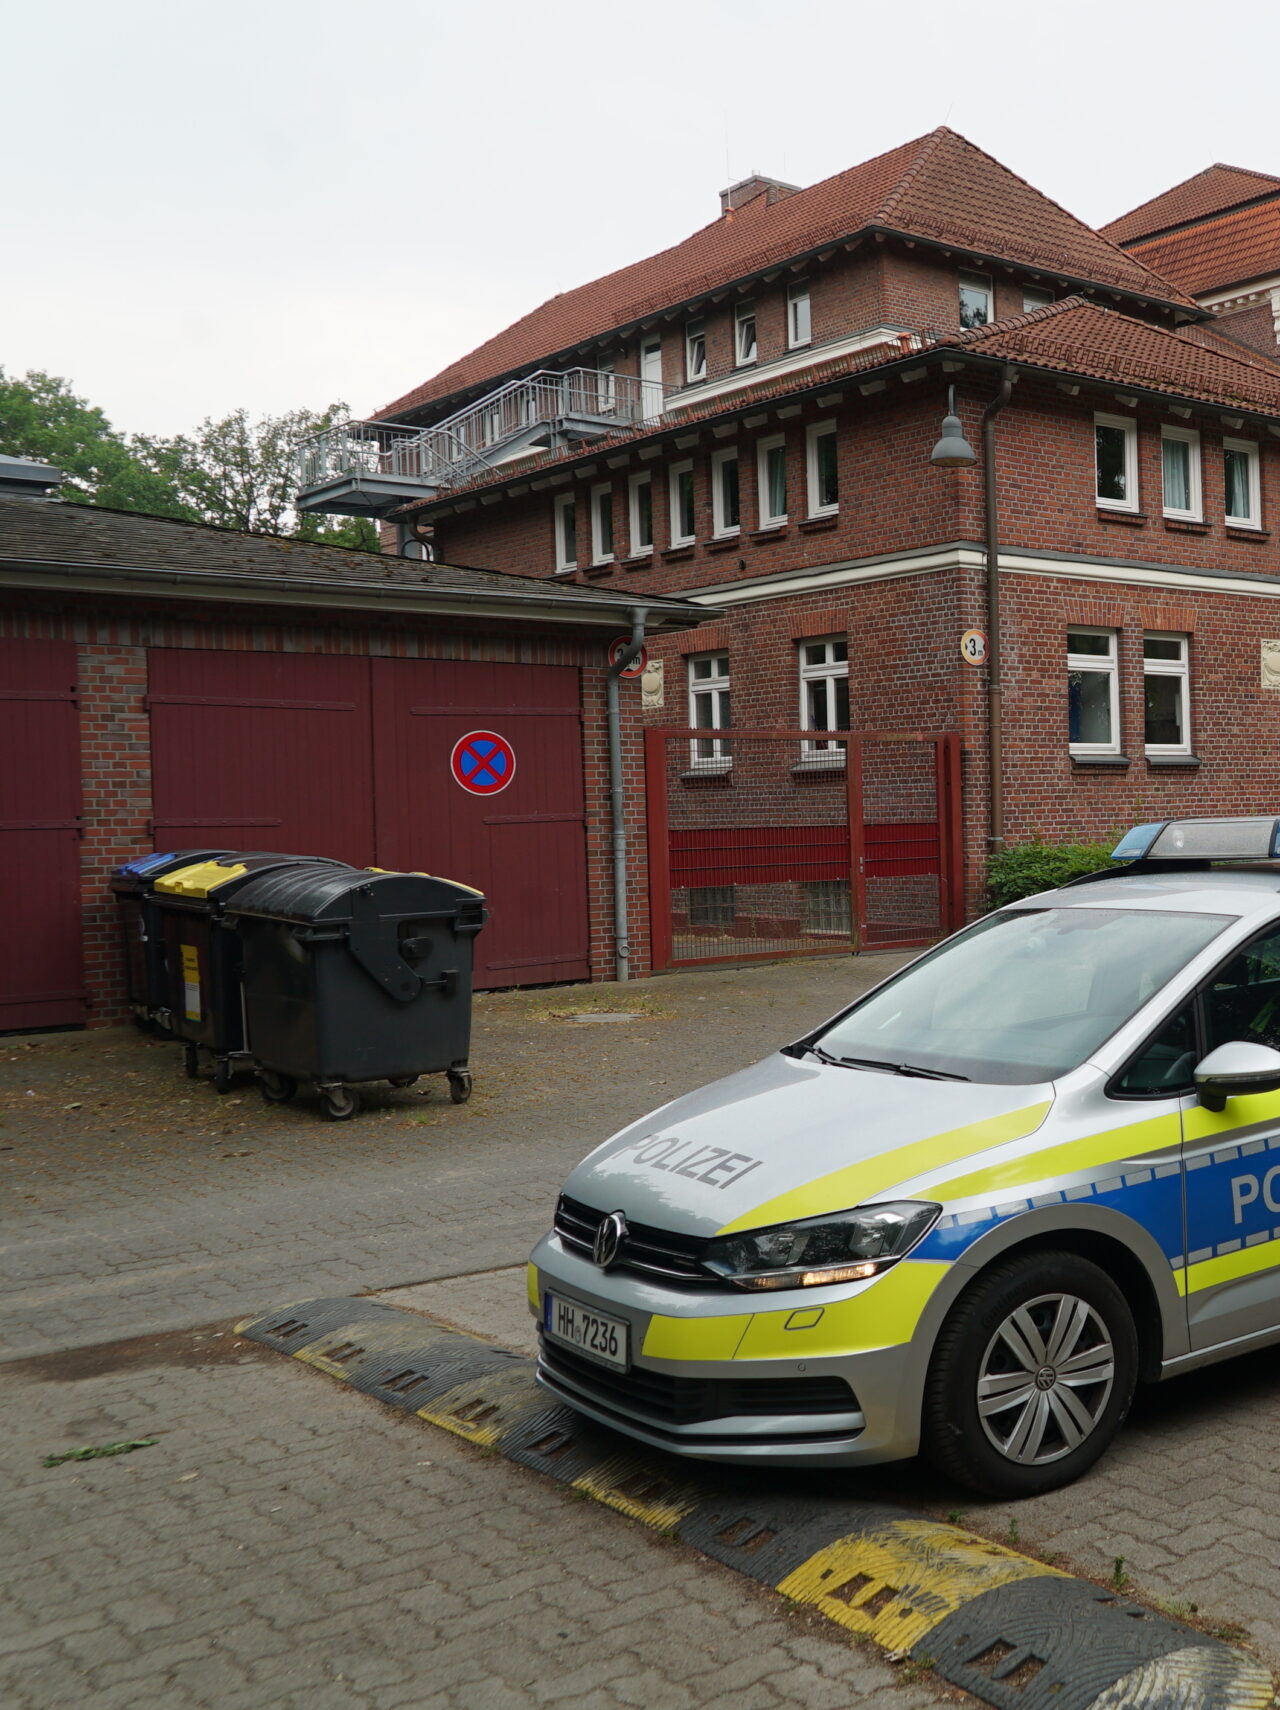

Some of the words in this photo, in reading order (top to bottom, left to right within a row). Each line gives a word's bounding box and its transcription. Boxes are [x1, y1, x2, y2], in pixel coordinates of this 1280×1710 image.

[969, 638, 976, 656] 3
[611, 1134, 764, 1190] POLIZEI
[558, 1302, 575, 1339] HH
[582, 1313, 618, 1357] 7236
